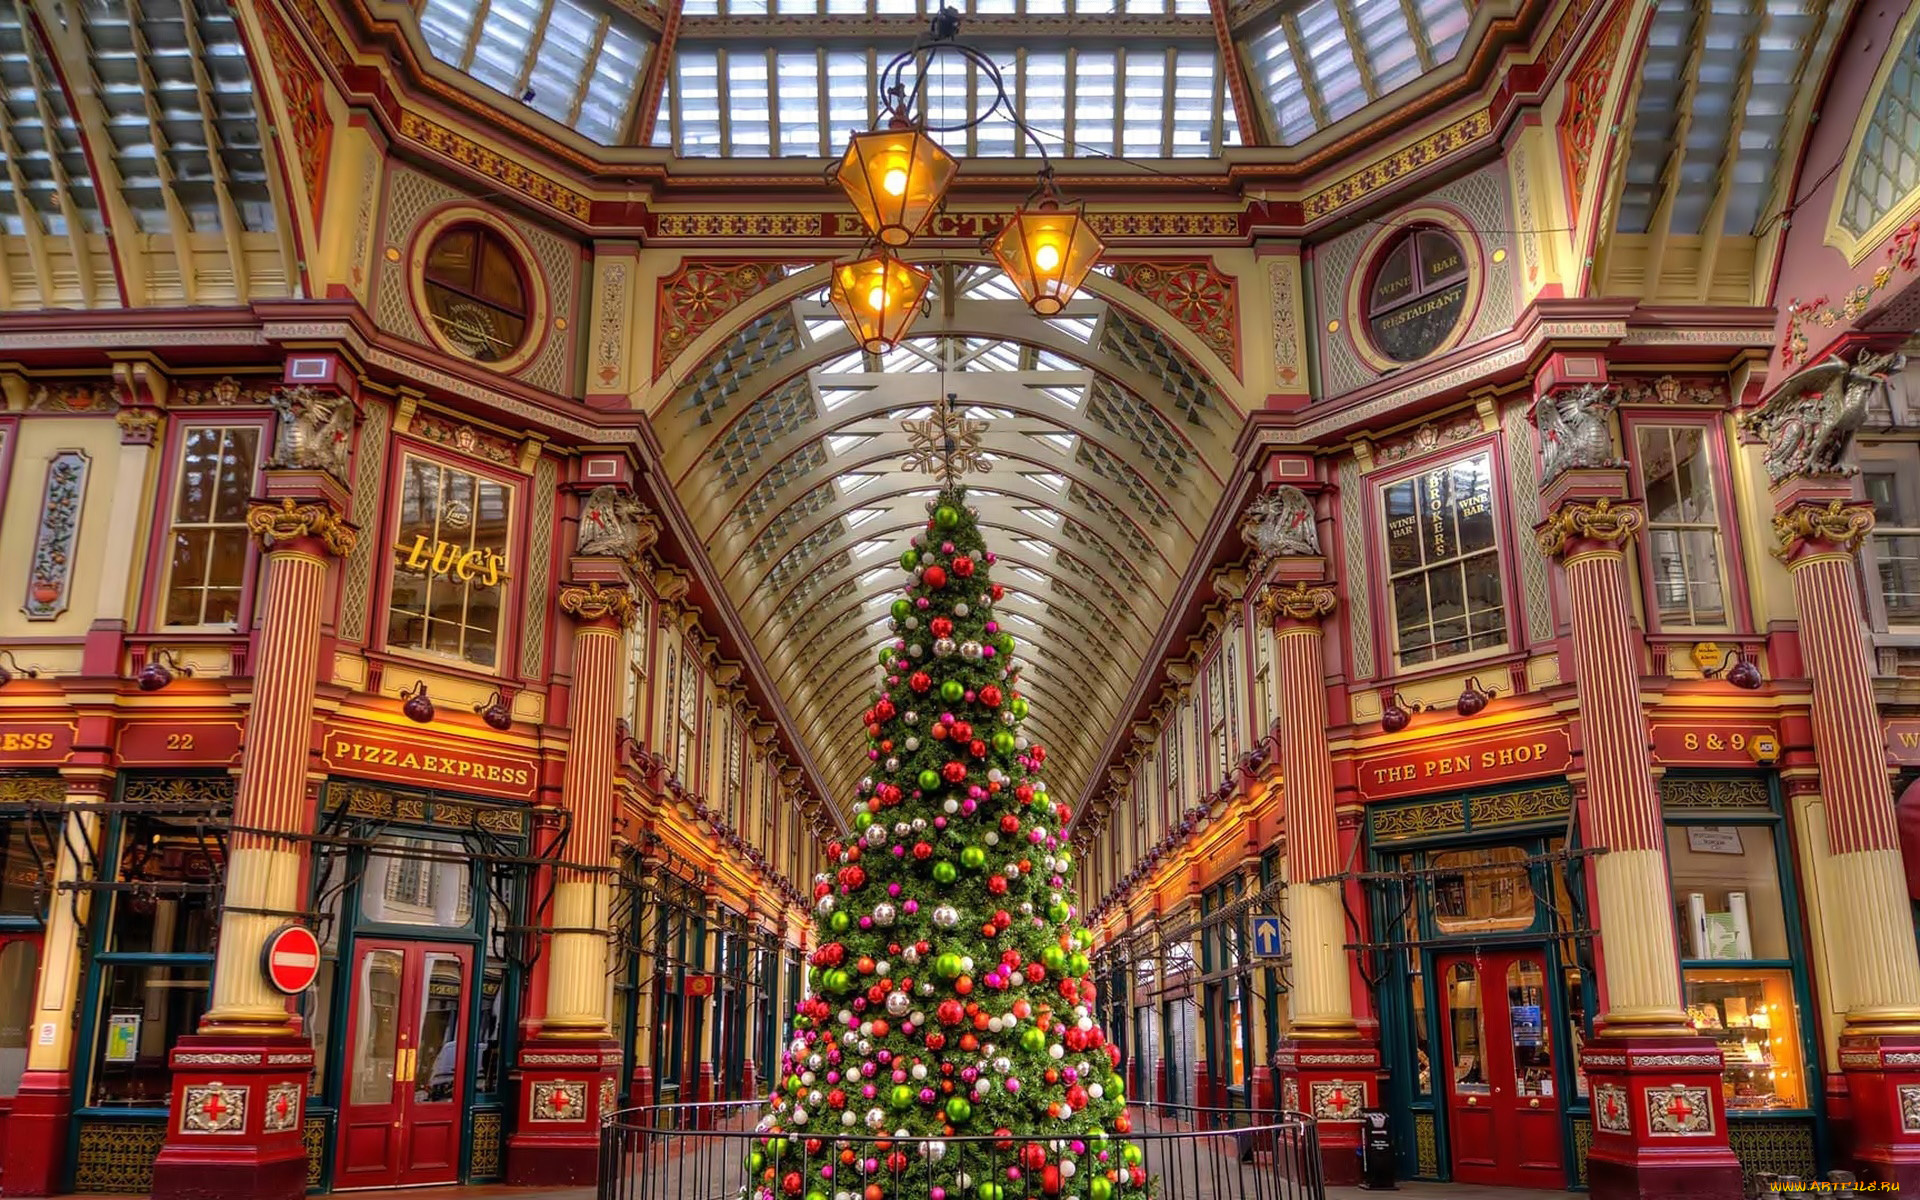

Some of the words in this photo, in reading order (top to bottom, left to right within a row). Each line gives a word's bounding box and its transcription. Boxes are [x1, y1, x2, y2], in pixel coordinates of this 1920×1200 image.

[1432, 256, 1458, 274] BAR
[1382, 290, 1462, 330] RESTAURANT
[1459, 493, 1488, 509] WINE
[1430, 477, 1445, 557] BROKERS
[1463, 505, 1485, 517] BAR
[1389, 515, 1416, 530] WINE
[1393, 526, 1413, 539] BAR
[167, 734, 195, 751] 22
[1684, 733, 1699, 750] 8
[1706, 733, 1725, 750] &
[1731, 733, 1745, 750] 9
[335, 741, 529, 785] PIZZAEXPRESS
[1374, 765, 1417, 784] THE
[1424, 755, 1471, 777] PEN
[1482, 743, 1548, 768] SHOP
